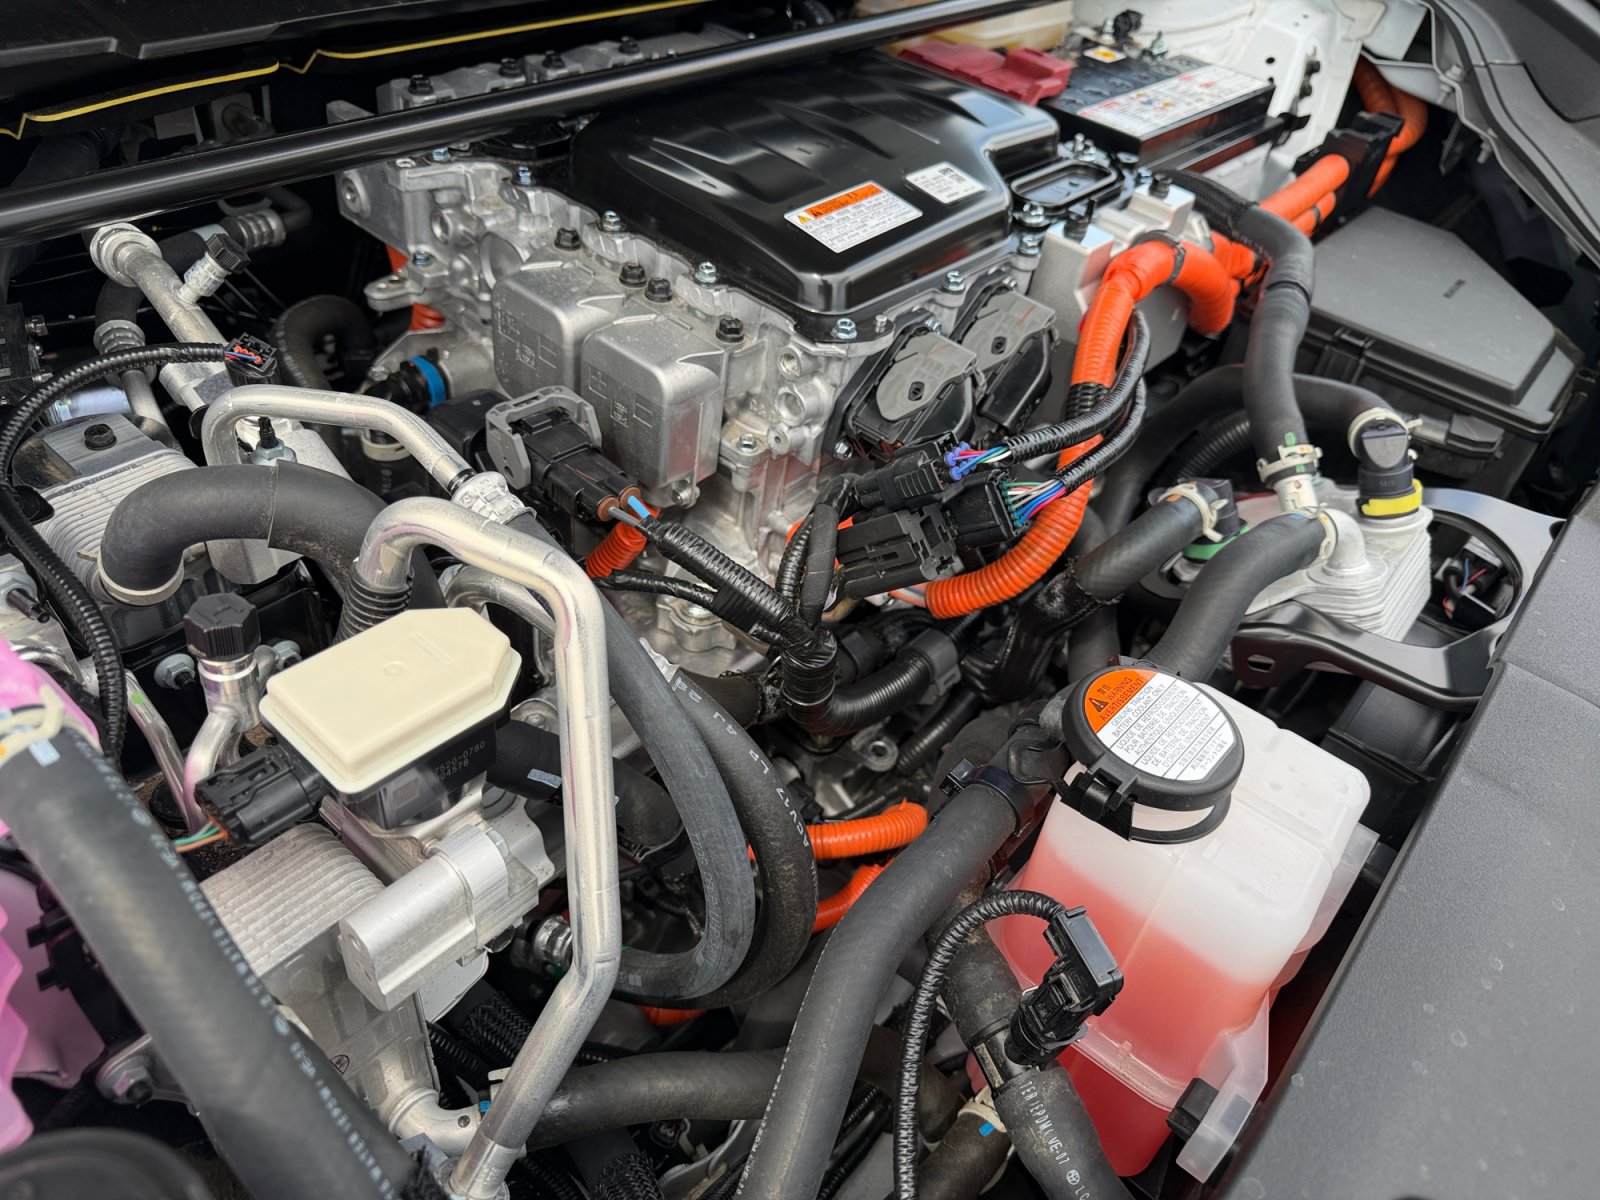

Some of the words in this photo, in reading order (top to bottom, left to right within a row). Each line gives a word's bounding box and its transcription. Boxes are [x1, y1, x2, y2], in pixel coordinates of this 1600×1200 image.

[1100, 677, 1144, 721] AVERTISSEMENT
[1104, 676, 1132, 700] WARNING
[1110, 704, 1133, 726] GENUINE
[1129, 685, 1153, 707] TRACTION
[1111, 716, 1133, 737] BATTERY
[1131, 695, 1153, 717] COOLANT
[1151, 683, 1165, 697] ONLY
[1116, 730, 1136, 749] LIQUIDE
[1133, 722, 1143, 730] DE
[1123, 738, 1139, 753] POUR
[1137, 717, 1159, 739] BATTERIE
[1156, 710, 1166, 719] DE
[1164, 689, 1187, 711] TRACTION
[1134, 723, 1164, 755] AUTHENTIQUE
[1163, 695, 1191, 724] UNIQUEMENT
[1151, 756, 1161, 766] DE
[1158, 735, 1181, 758] BATTERIE
[1178, 727, 1188, 736] DE
[1185, 705, 1207, 728] TRACTION
[1183, 713, 1210, 743] UNIQUEMENT
[1140, 744, 1160, 764] LIQUIDE
[1157, 737, 1167, 746] DE
[775, 785, 810, 846] ACV17
